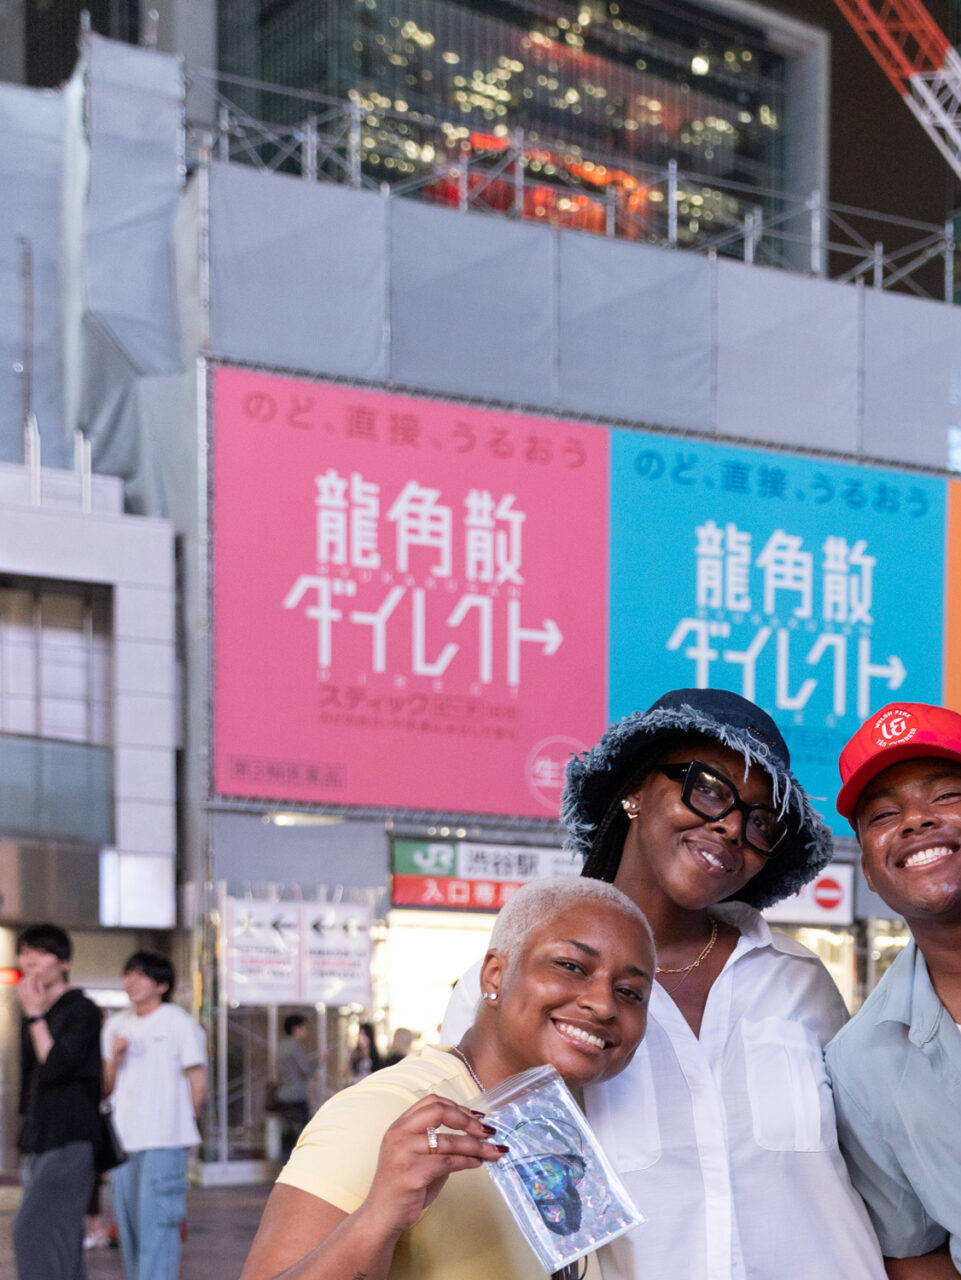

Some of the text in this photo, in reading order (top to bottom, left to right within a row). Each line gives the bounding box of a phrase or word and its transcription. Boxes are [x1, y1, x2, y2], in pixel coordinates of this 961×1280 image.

[242, 391, 588, 470] のど、直接、うるおう
[634, 448, 930, 517] のど、直接、うるおう
[314, 469, 526, 586] 龍角散
[695, 520, 877, 625] 龍角散
[283, 574, 563, 685] ダイレクト
[667, 617, 907, 721] ダイレクト
[414, 844, 454, 874] JR
